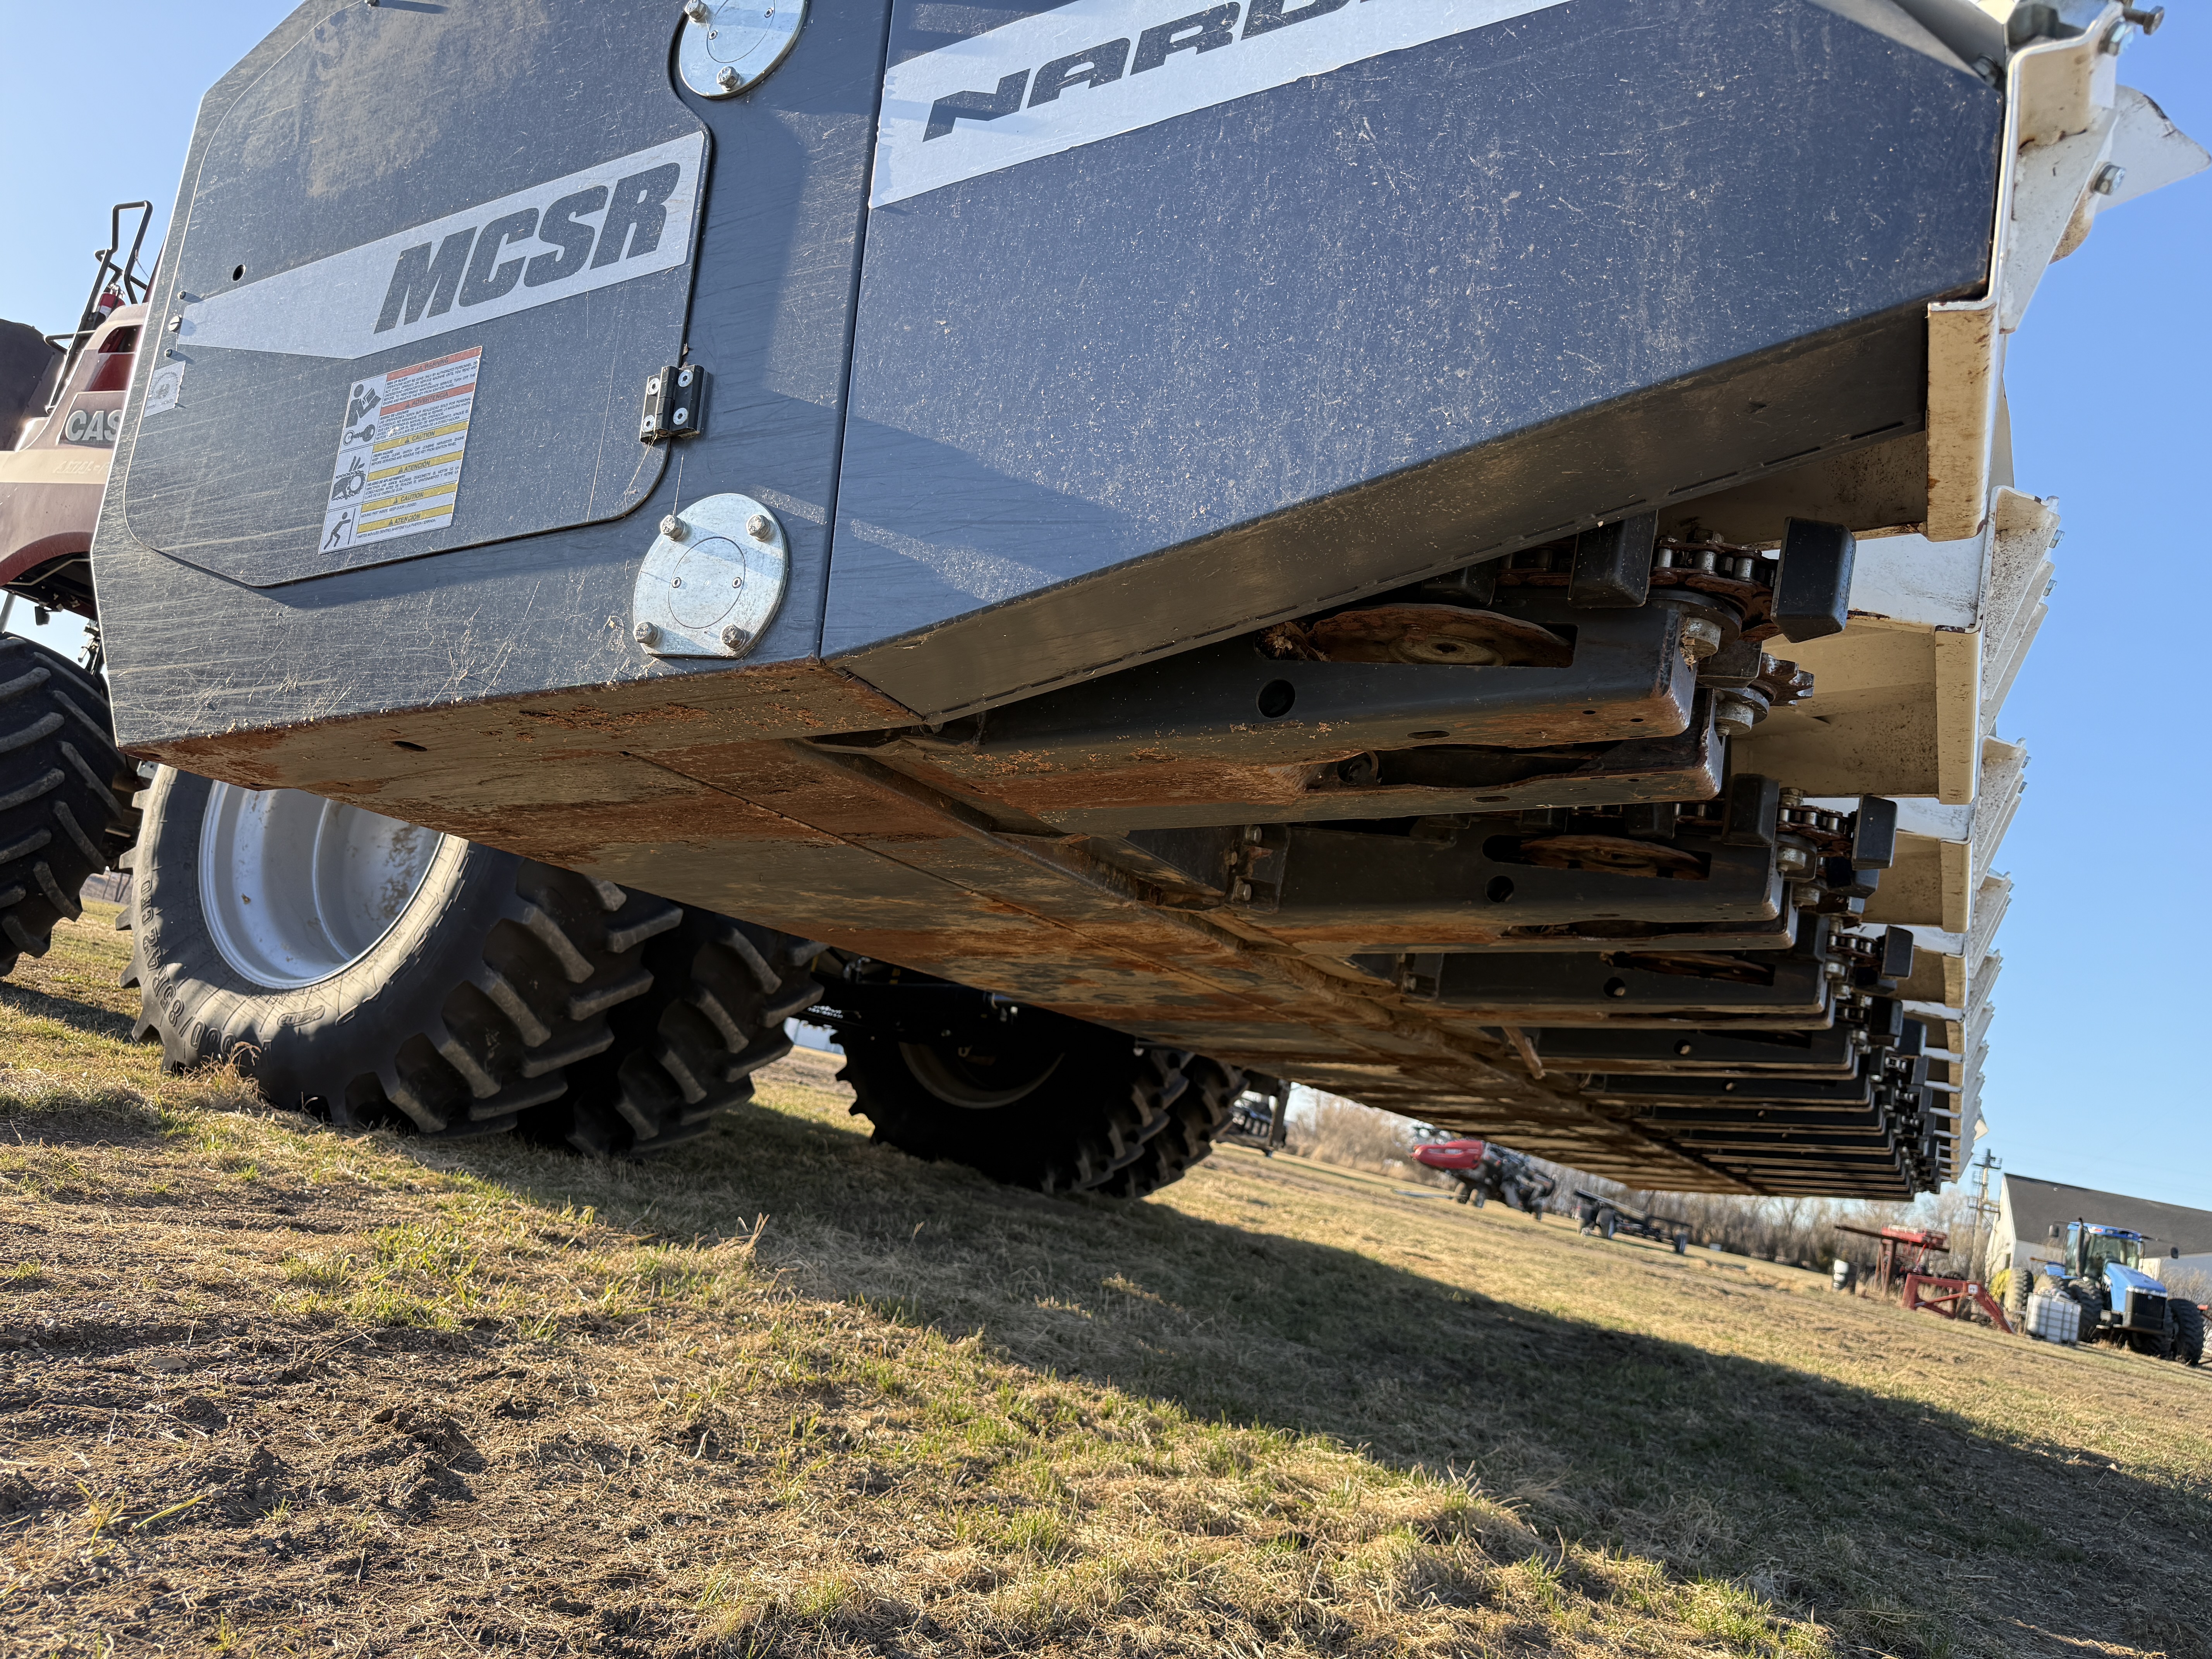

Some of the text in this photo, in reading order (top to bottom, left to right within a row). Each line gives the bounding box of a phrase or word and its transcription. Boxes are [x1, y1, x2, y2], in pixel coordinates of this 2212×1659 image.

[922, 0, 1371, 142] NARD
[373, 162, 680, 334] MCSR
[424, 357, 448, 369] WARNING
[412, 391, 448, 406] ADVERTENCIA
[412, 430, 435, 441] CAUTION
[404, 459, 430, 472] ATENCIÓN
[400, 491, 424, 502] CAUTION
[394, 512, 421, 524] ATENCIÓN
